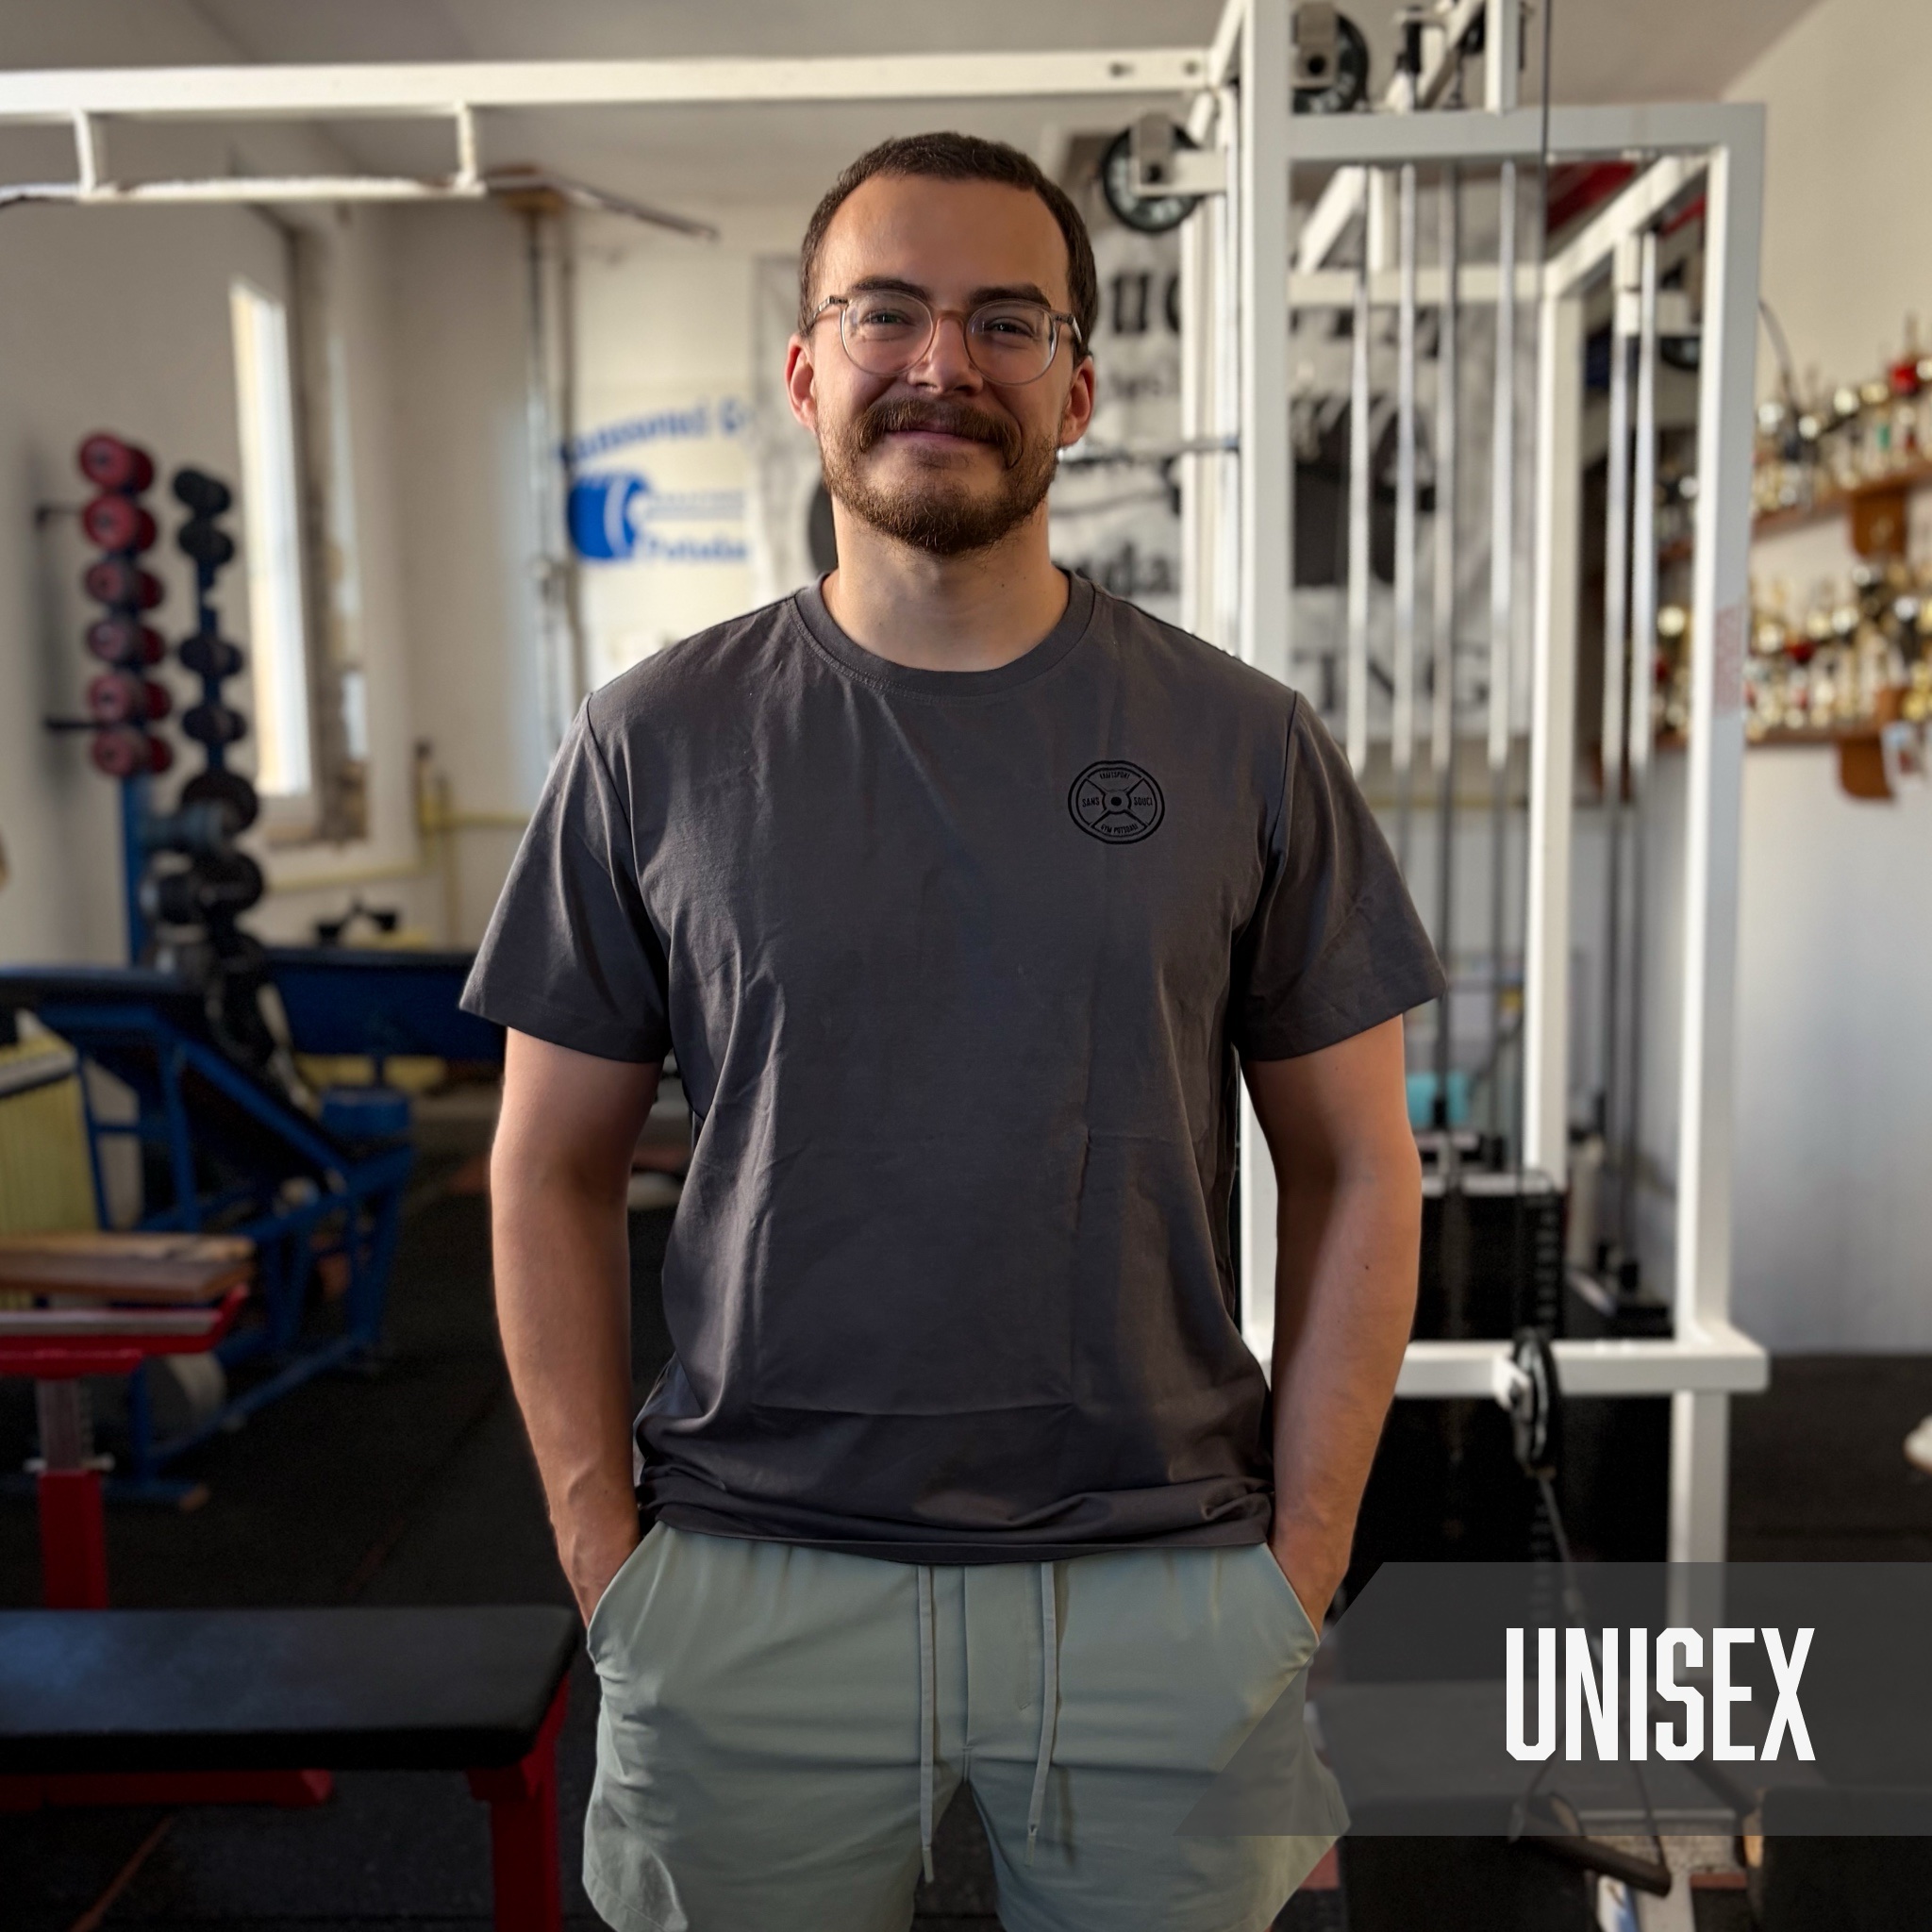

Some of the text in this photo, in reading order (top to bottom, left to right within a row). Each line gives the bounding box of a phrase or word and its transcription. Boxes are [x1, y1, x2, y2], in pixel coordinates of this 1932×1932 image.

[1082, 796, 1153, 808] SANS SOUCI
[1100, 824, 1139, 834] GYM POTSDAM
